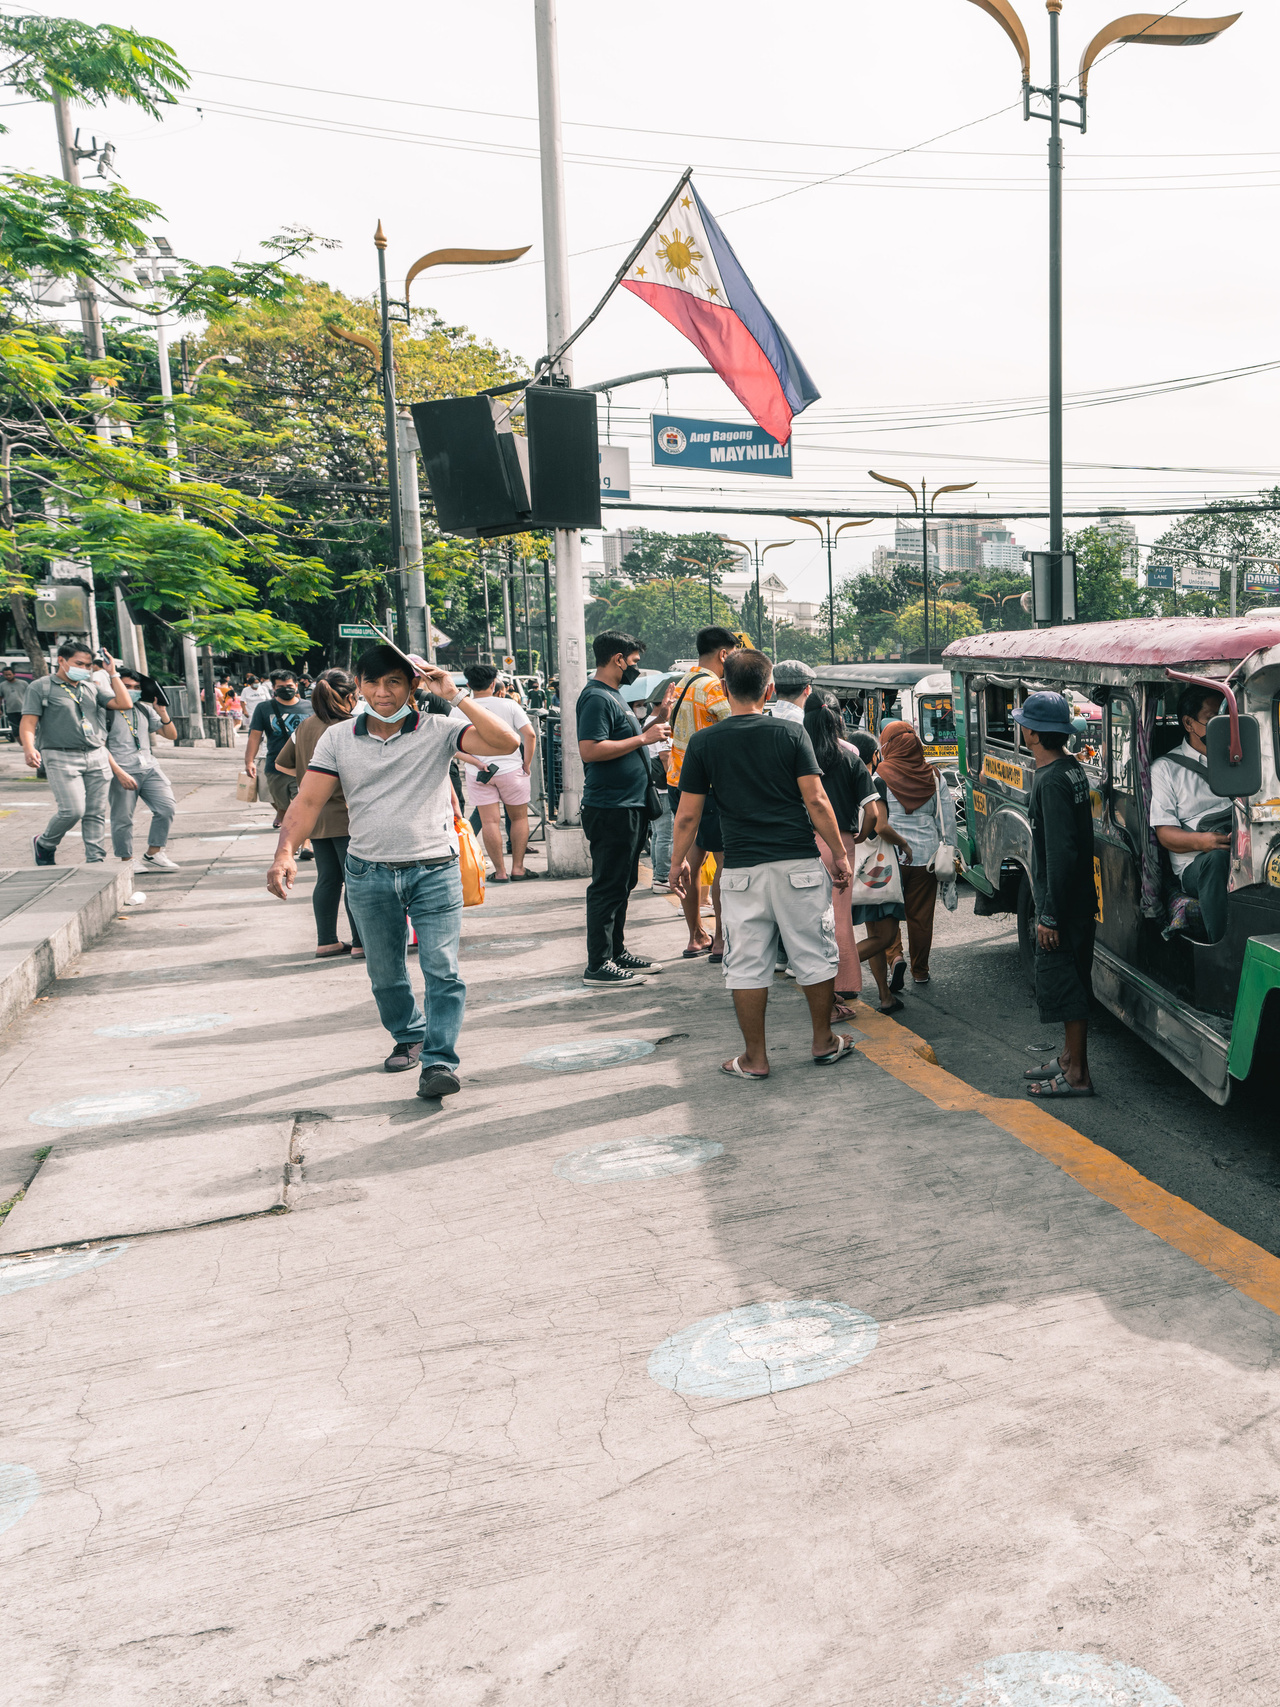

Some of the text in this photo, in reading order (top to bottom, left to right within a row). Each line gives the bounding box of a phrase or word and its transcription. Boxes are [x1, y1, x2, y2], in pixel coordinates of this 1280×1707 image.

[689, 431, 711, 443] Ang
[712, 430, 753, 443] Bagong
[710, 443, 789, 463] MAYNILA!
[1247, 574, 1280, 584] DAVIES
